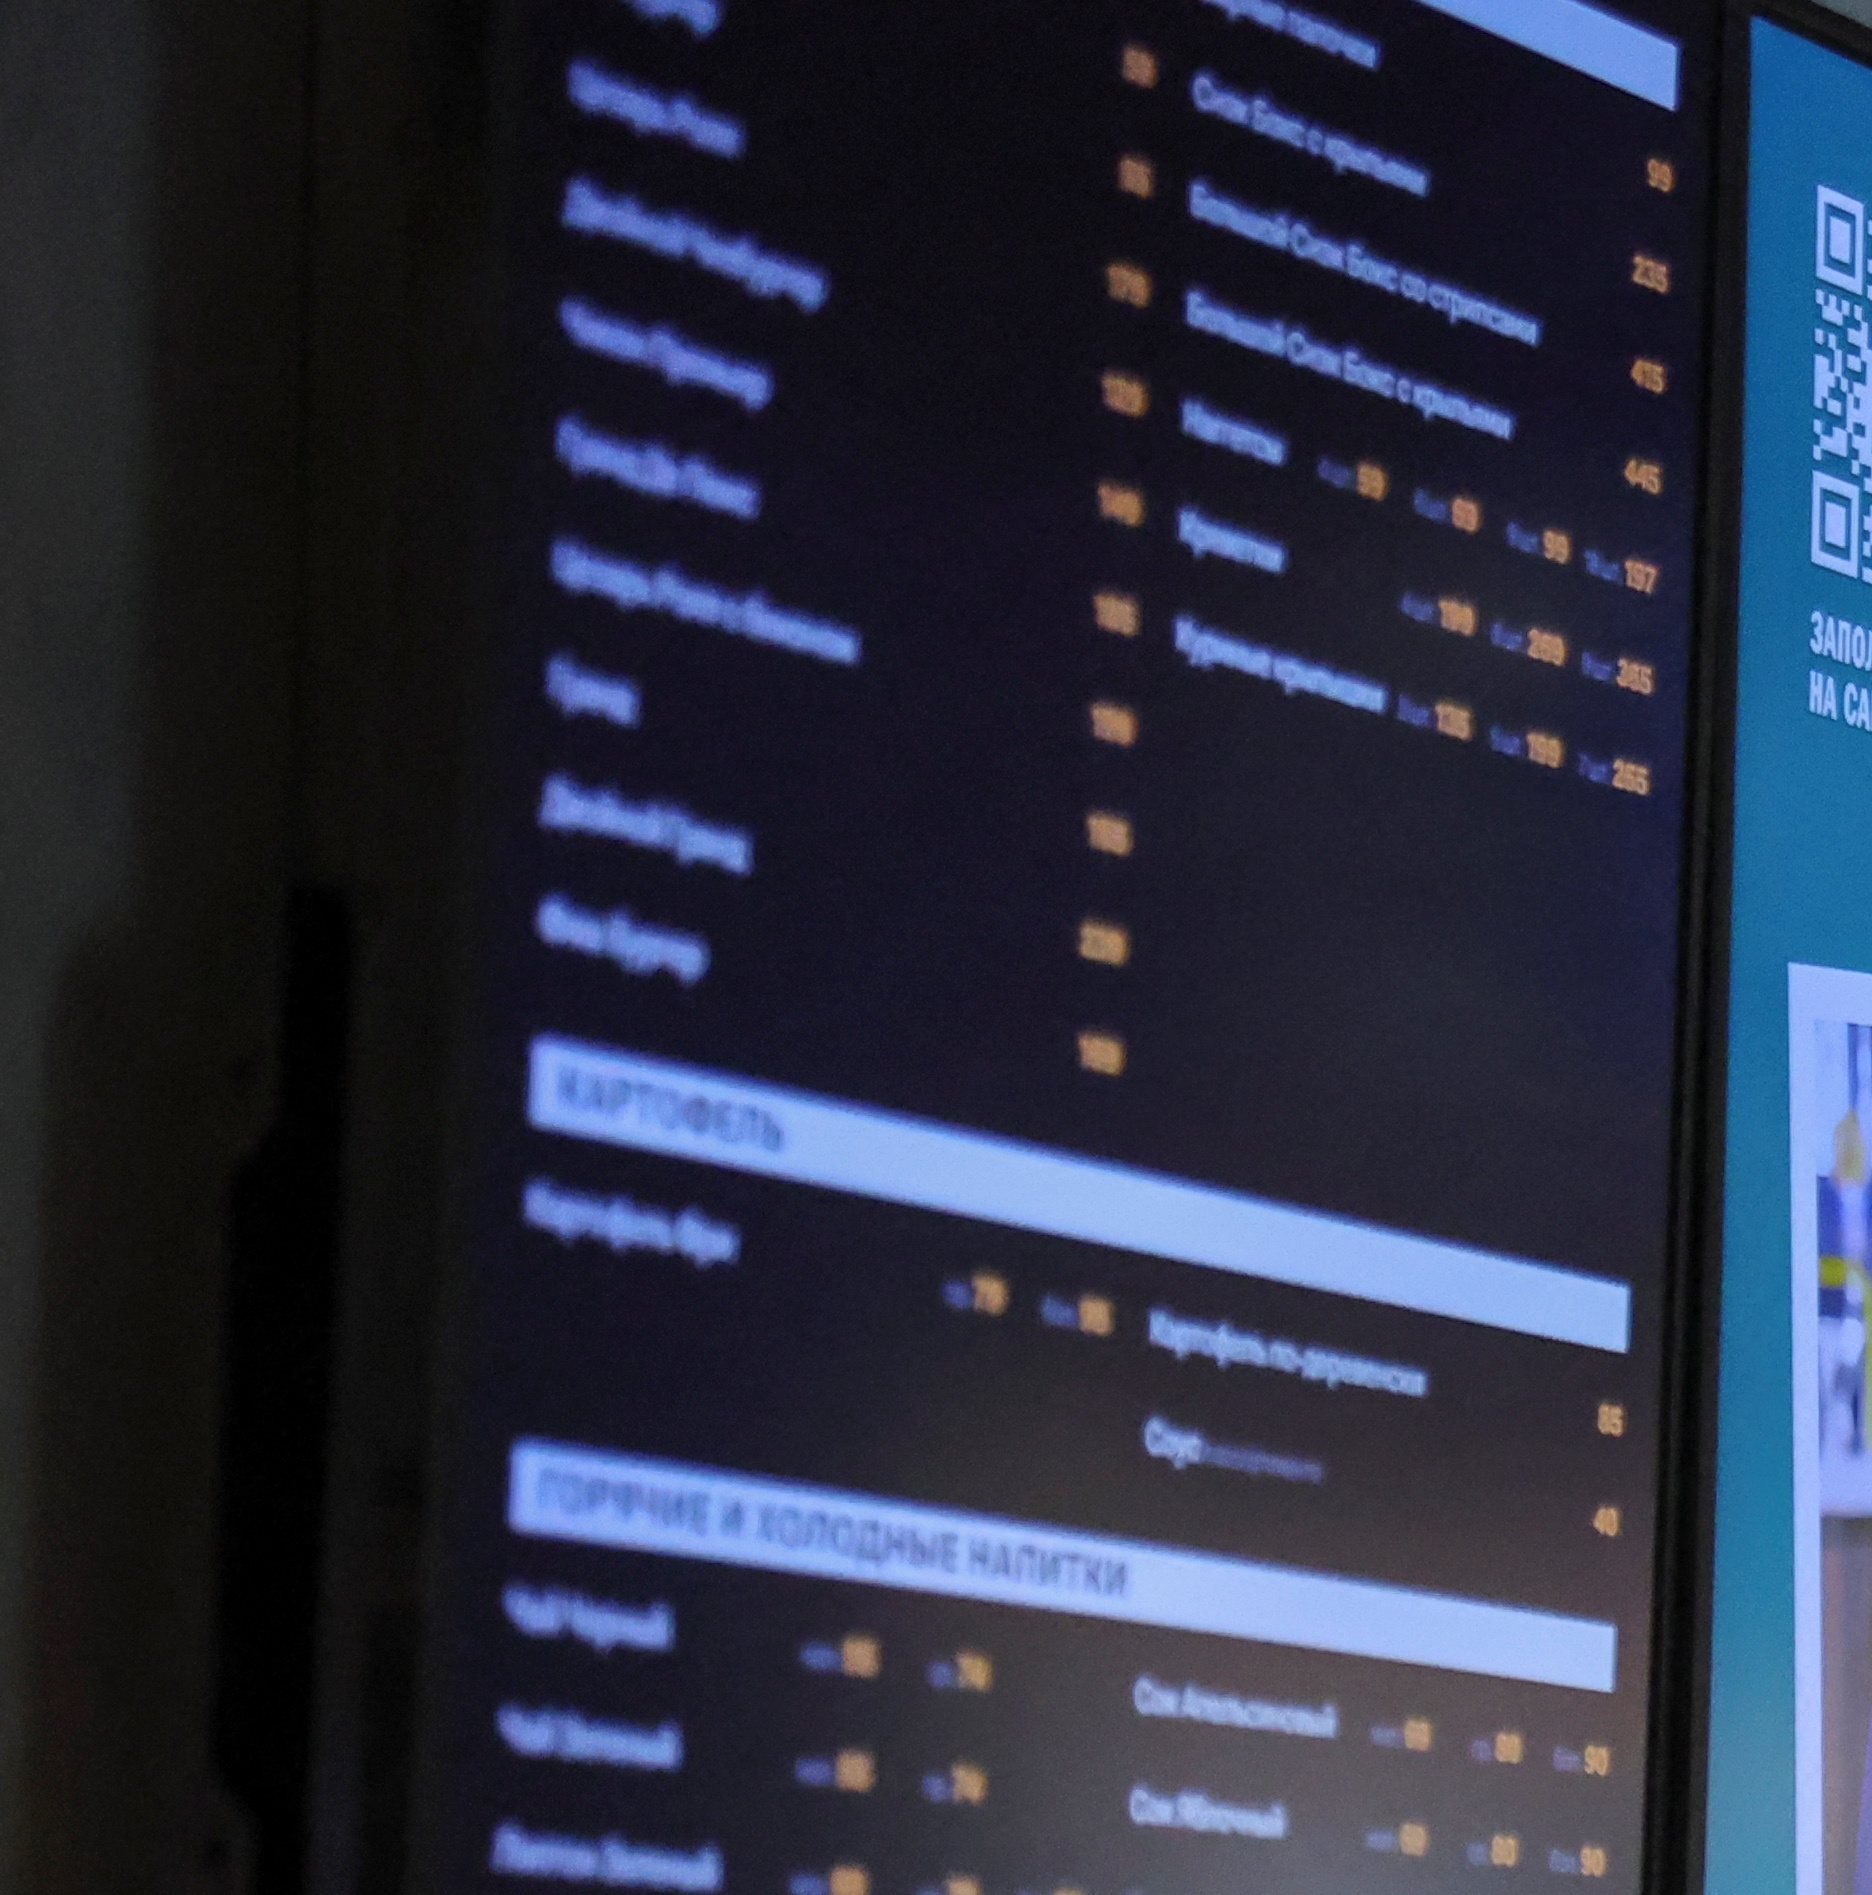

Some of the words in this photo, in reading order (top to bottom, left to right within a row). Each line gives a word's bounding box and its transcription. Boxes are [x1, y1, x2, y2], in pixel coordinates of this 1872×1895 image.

[1809, 669, 1837, 721] НА
[535, 1467, 710, 1540] ГОРЯЧИЕ
[722, 1499, 743, 1527] И
[756, 1504, 960, 1574] ХОЛОДНЫЕ
[967, 1545, 1131, 1598] НАПИТКИ
